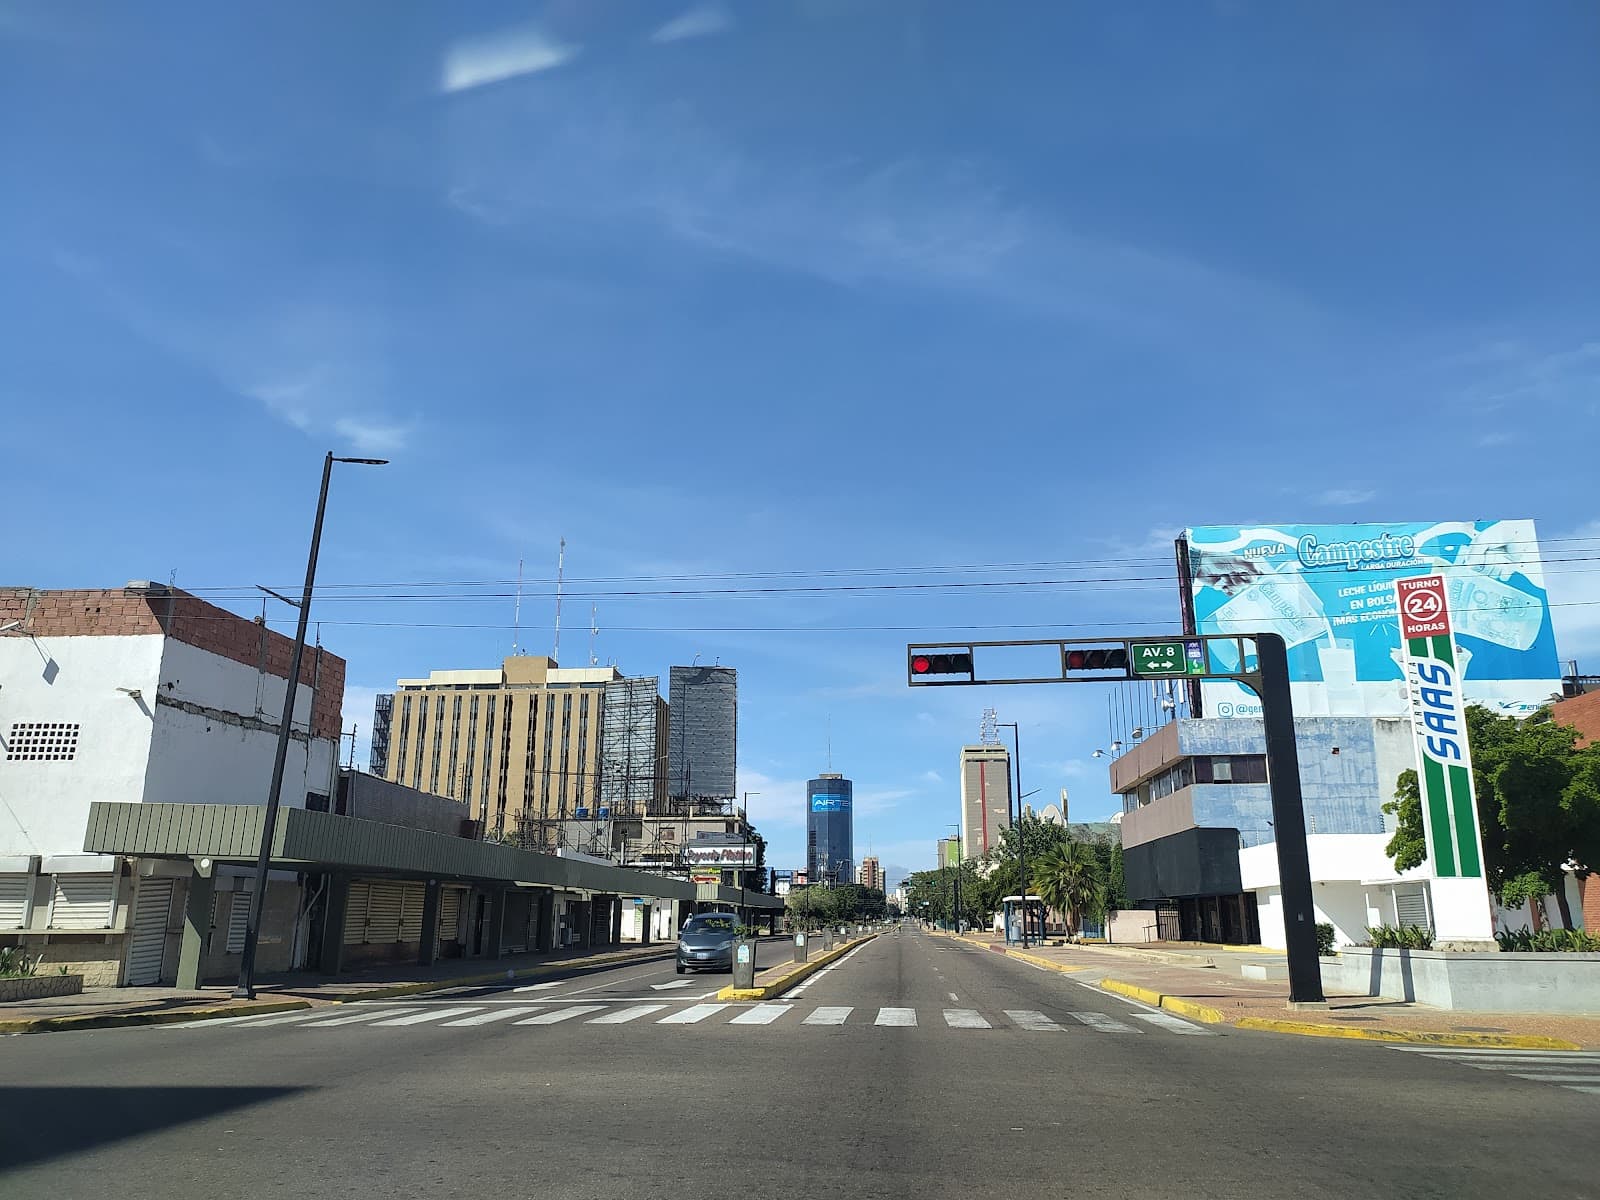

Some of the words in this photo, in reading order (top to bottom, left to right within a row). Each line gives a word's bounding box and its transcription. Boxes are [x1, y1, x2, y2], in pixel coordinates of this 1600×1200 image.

[1243, 543, 1286, 560] NUEVA
[1297, 533, 1414, 571] Campestre
[1361, 562, 1385, 570] LARGA
[1386, 558, 1424, 569] DURACIÓN
[1401, 579, 1440, 590] TURNO
[1338, 585, 1366, 597] LECHE
[1350, 599, 1364, 610] EN
[1409, 596, 1437, 613] 24
[1407, 622, 1446, 633] HORAS
[1142, 647, 1163, 657] AV.
[1166, 647, 1175, 657] 8
[1408, 662, 1425, 735] FARMACIA
[1417, 663, 1461, 760] SAAS
